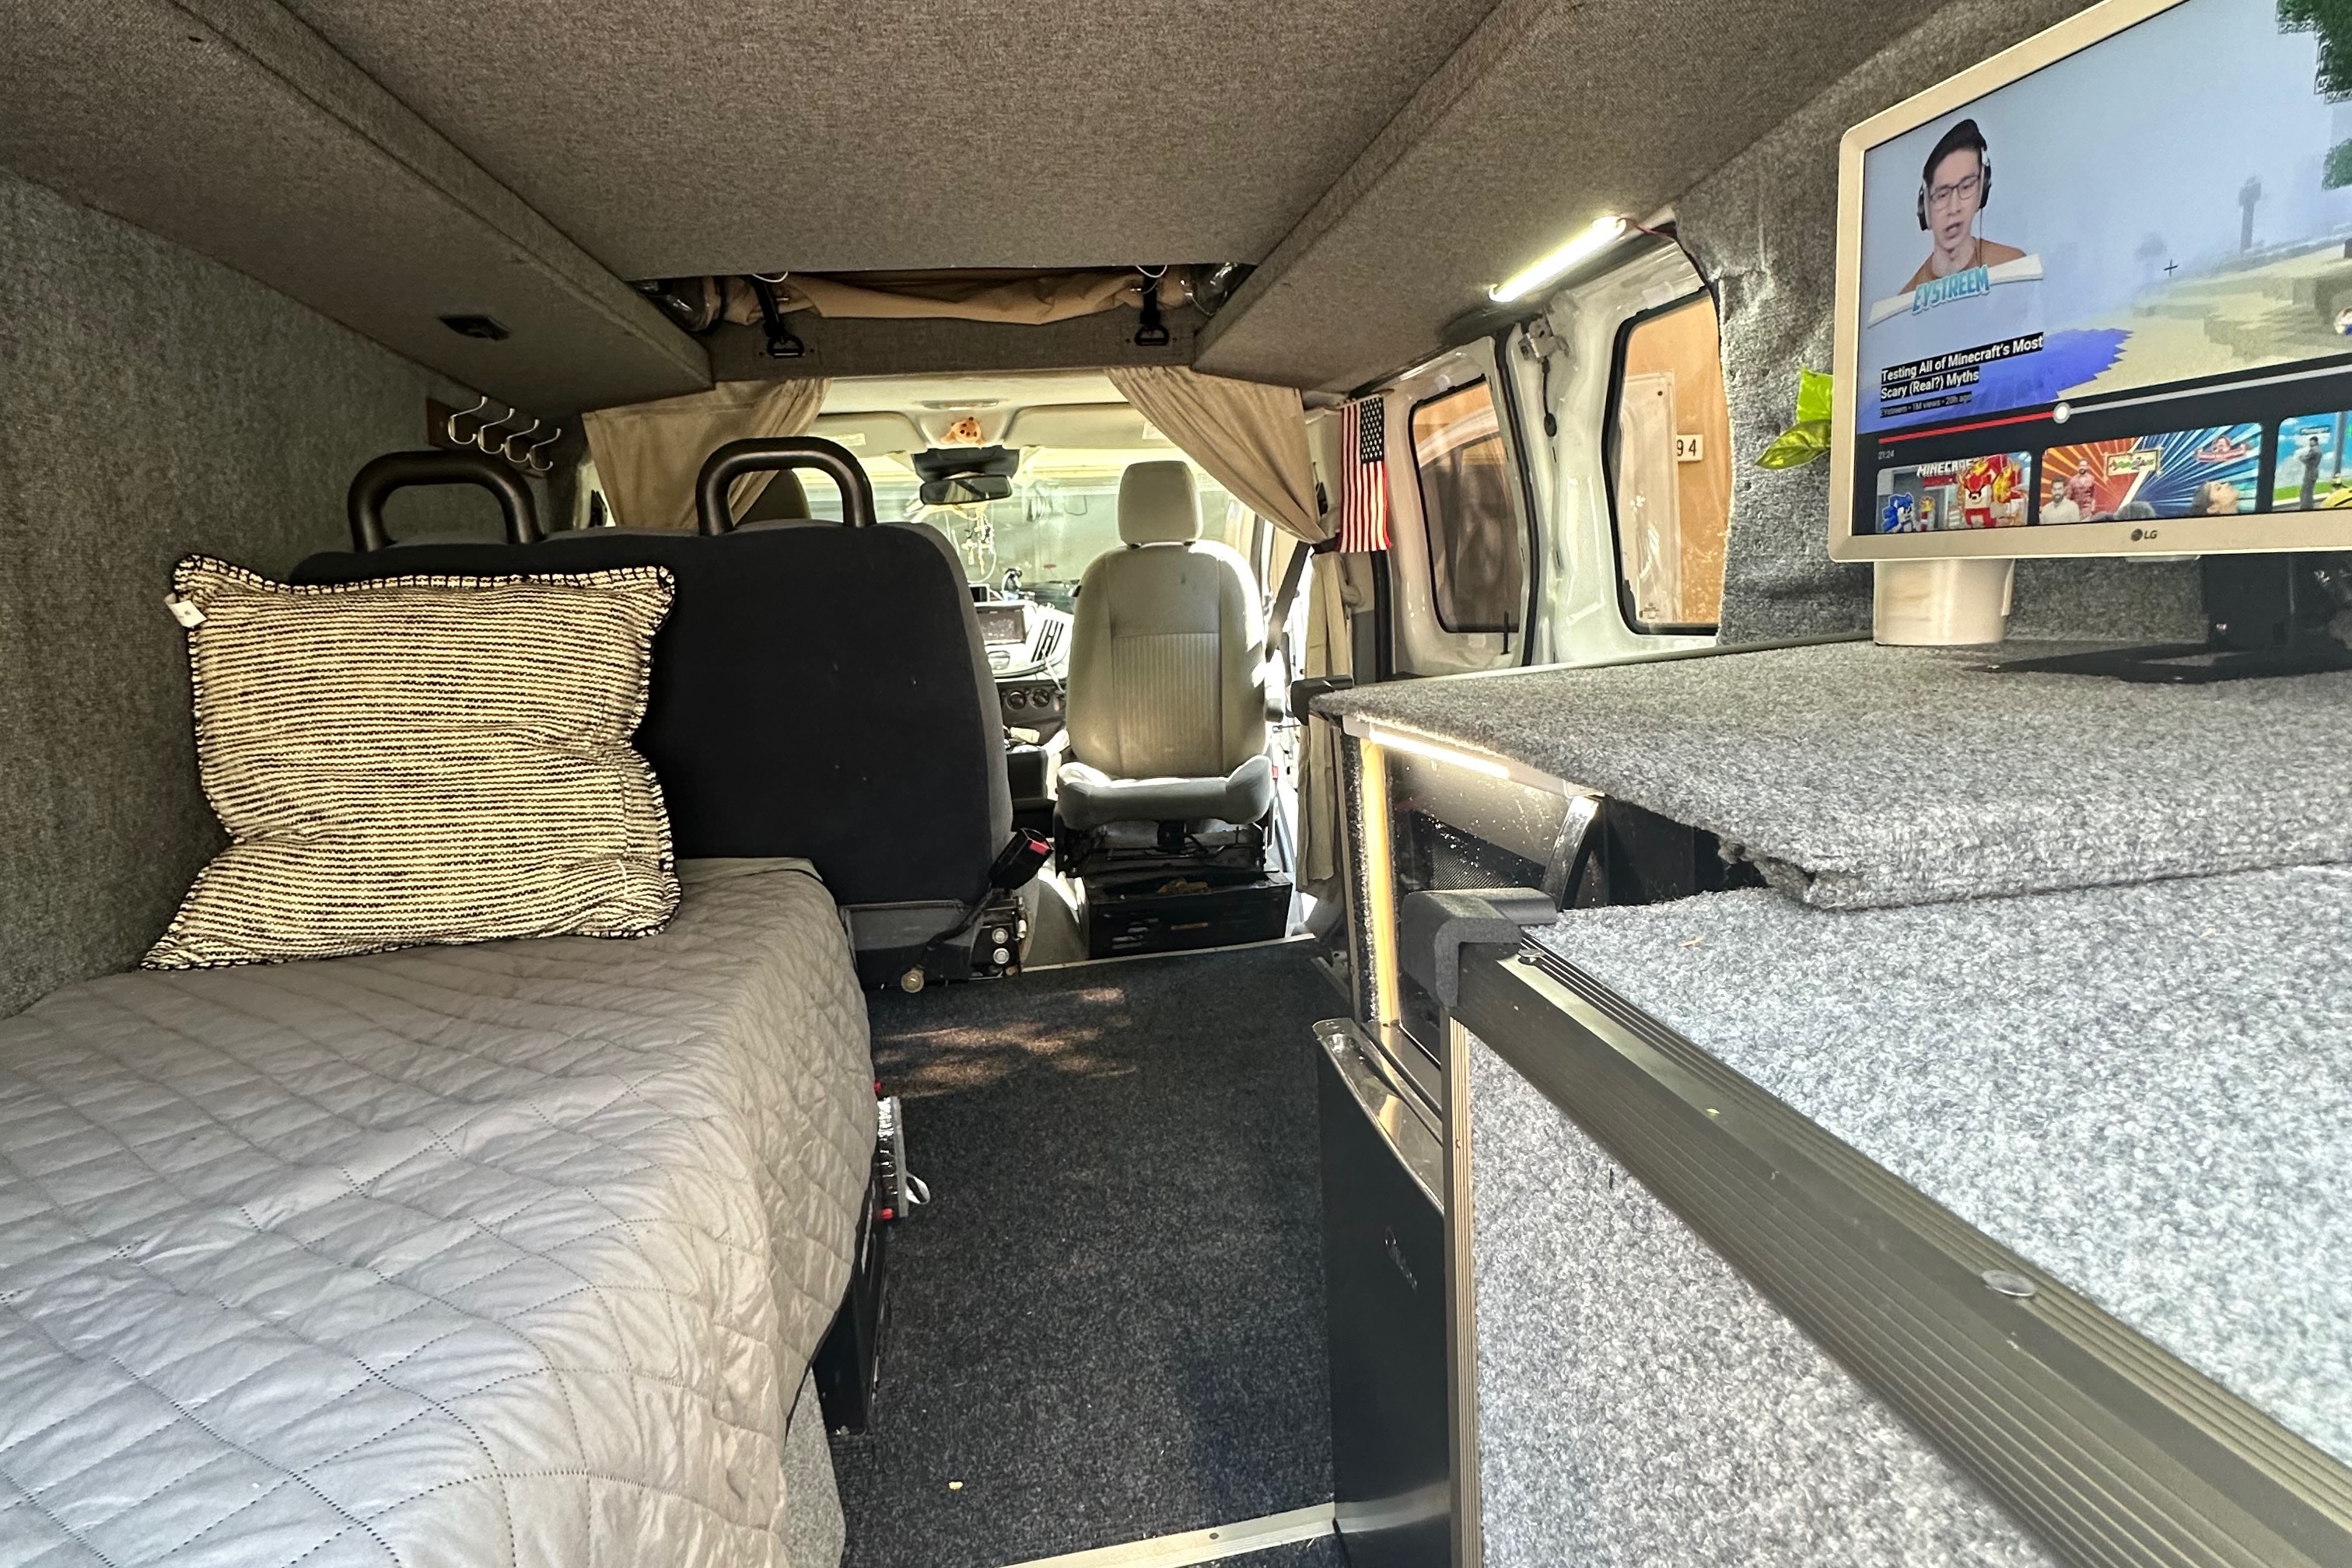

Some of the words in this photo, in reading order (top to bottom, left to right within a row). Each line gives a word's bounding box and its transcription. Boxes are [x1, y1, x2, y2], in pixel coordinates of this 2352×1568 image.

[1913, 264, 1990, 313] EYSTREEM
[1882, 366, 1916, 382] Testing
[1919, 360, 1933, 374] All
[1934, 356, 1946, 370] of
[1948, 344, 2010, 367] Minecraft's
[2012, 336, 2043, 354] Most
[1881, 386, 1907, 399] Scary
[1909, 375, 1944, 396] (Real?)
[1945, 370, 1979, 387] Myths
[1923, 399, 1941, 408] views
[1959, 394, 1972, 404] ago
[1677, 439, 1696, 457] 94
[1916, 459, 1974, 478] MINECRAF
[2144, 530, 2158, 539] LG
